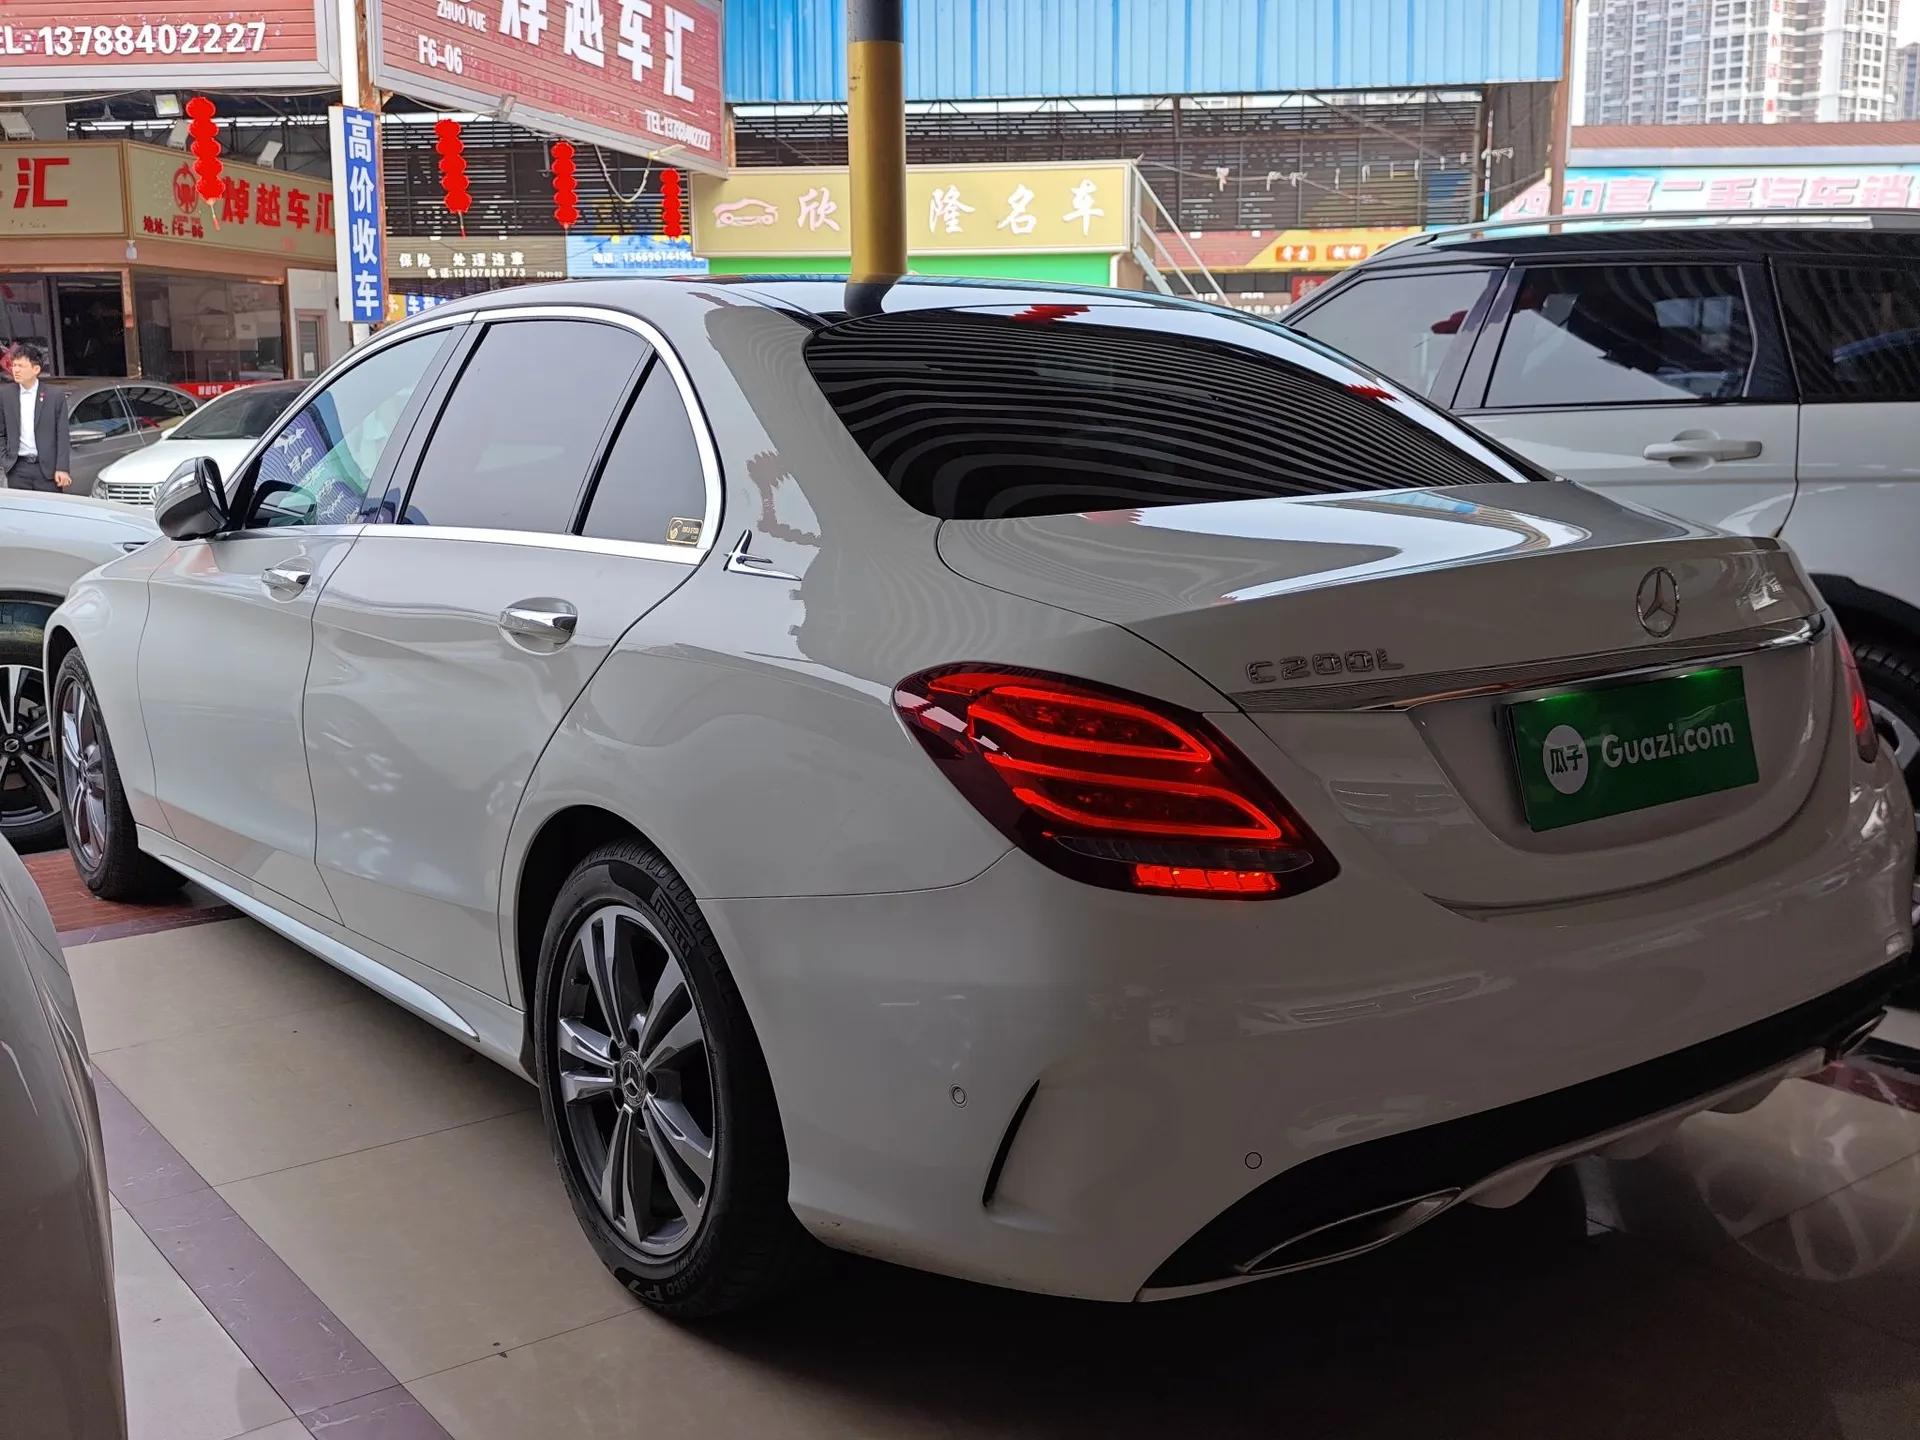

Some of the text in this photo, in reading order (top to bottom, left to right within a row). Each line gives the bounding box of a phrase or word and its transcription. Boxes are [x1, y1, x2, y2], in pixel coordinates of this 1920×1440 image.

[437, 0, 488, 33] ZHUO YUE
[418, 34, 463, 75] F6-06
[0, 157, 70, 209] 汇
[346, 114, 380, 317] 高价收车
[400, 252, 524, 267] 保险 处理违章
[1246, 648, 1404, 683] C200L
[1549, 744, 1584, 775] 瓜子
[1601, 718, 1735, 768] Guazi.com
